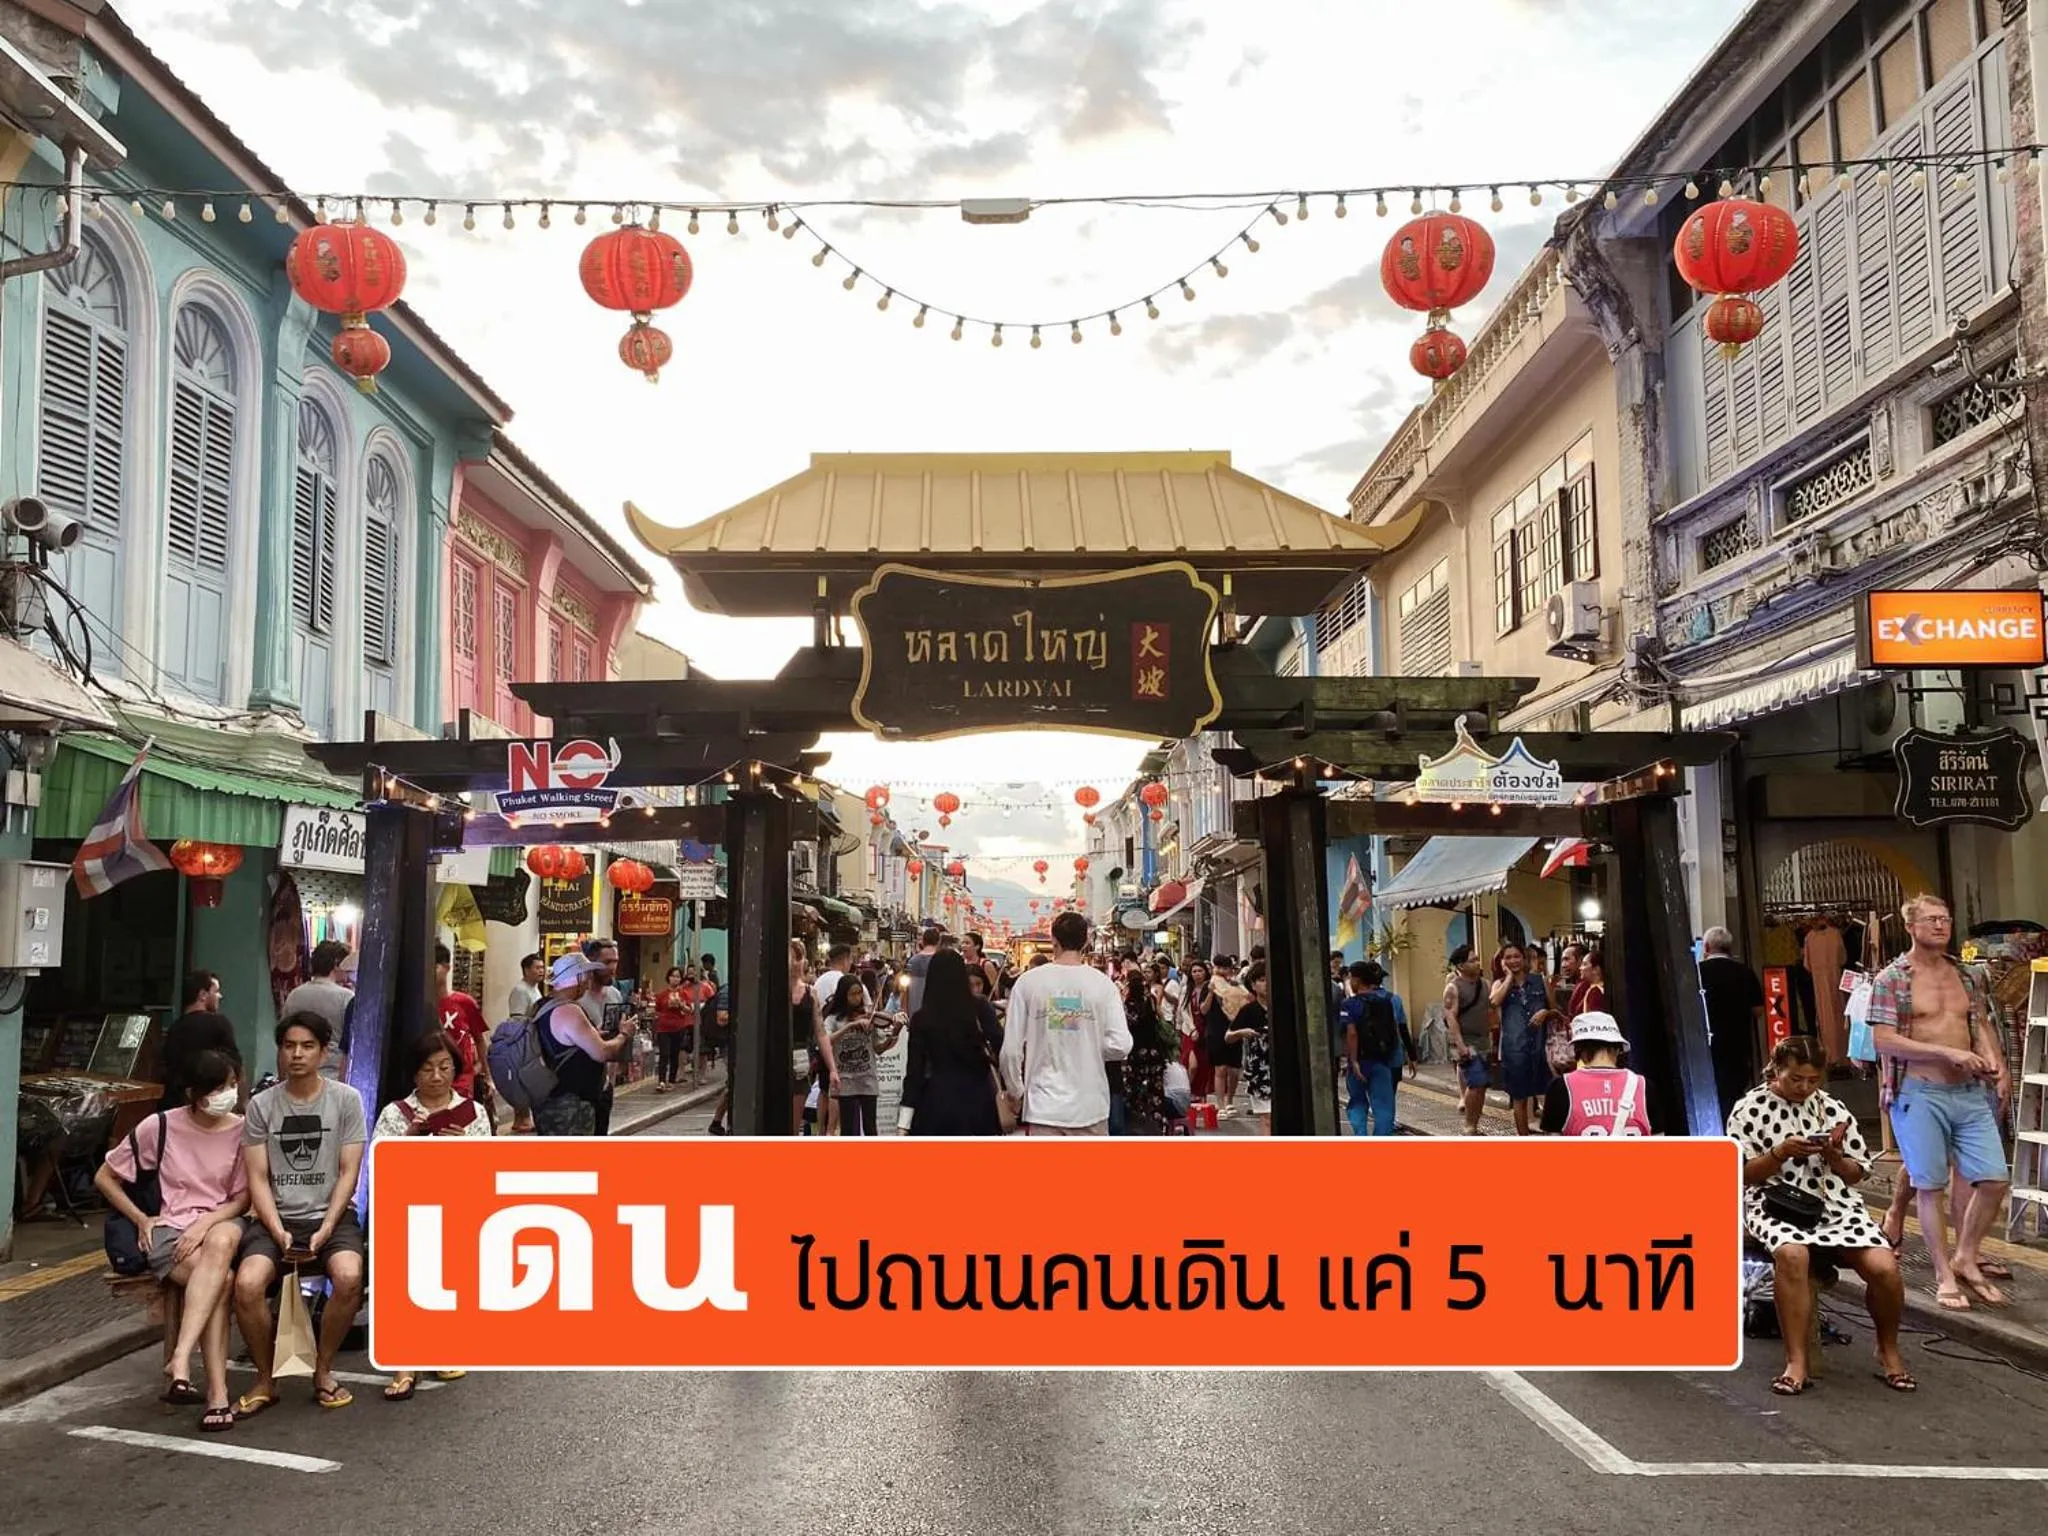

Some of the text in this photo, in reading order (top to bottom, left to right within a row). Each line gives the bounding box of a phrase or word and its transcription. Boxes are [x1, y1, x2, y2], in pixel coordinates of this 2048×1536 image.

[1878, 613, 2037, 645] EXCHANGE
[1138, 624, 1167, 698] 大坡
[963, 679, 1072, 698] LARDYAI
[509, 740, 608, 792] NO
[1493, 770, 1560, 788] ต้องชม
[1930, 776, 1999, 791] SIRIRAT
[501, 792, 614, 808] Phuket Walking Street
[553, 882, 581, 892] TAI
[1582, 1098, 1636, 1118] BUTLR
